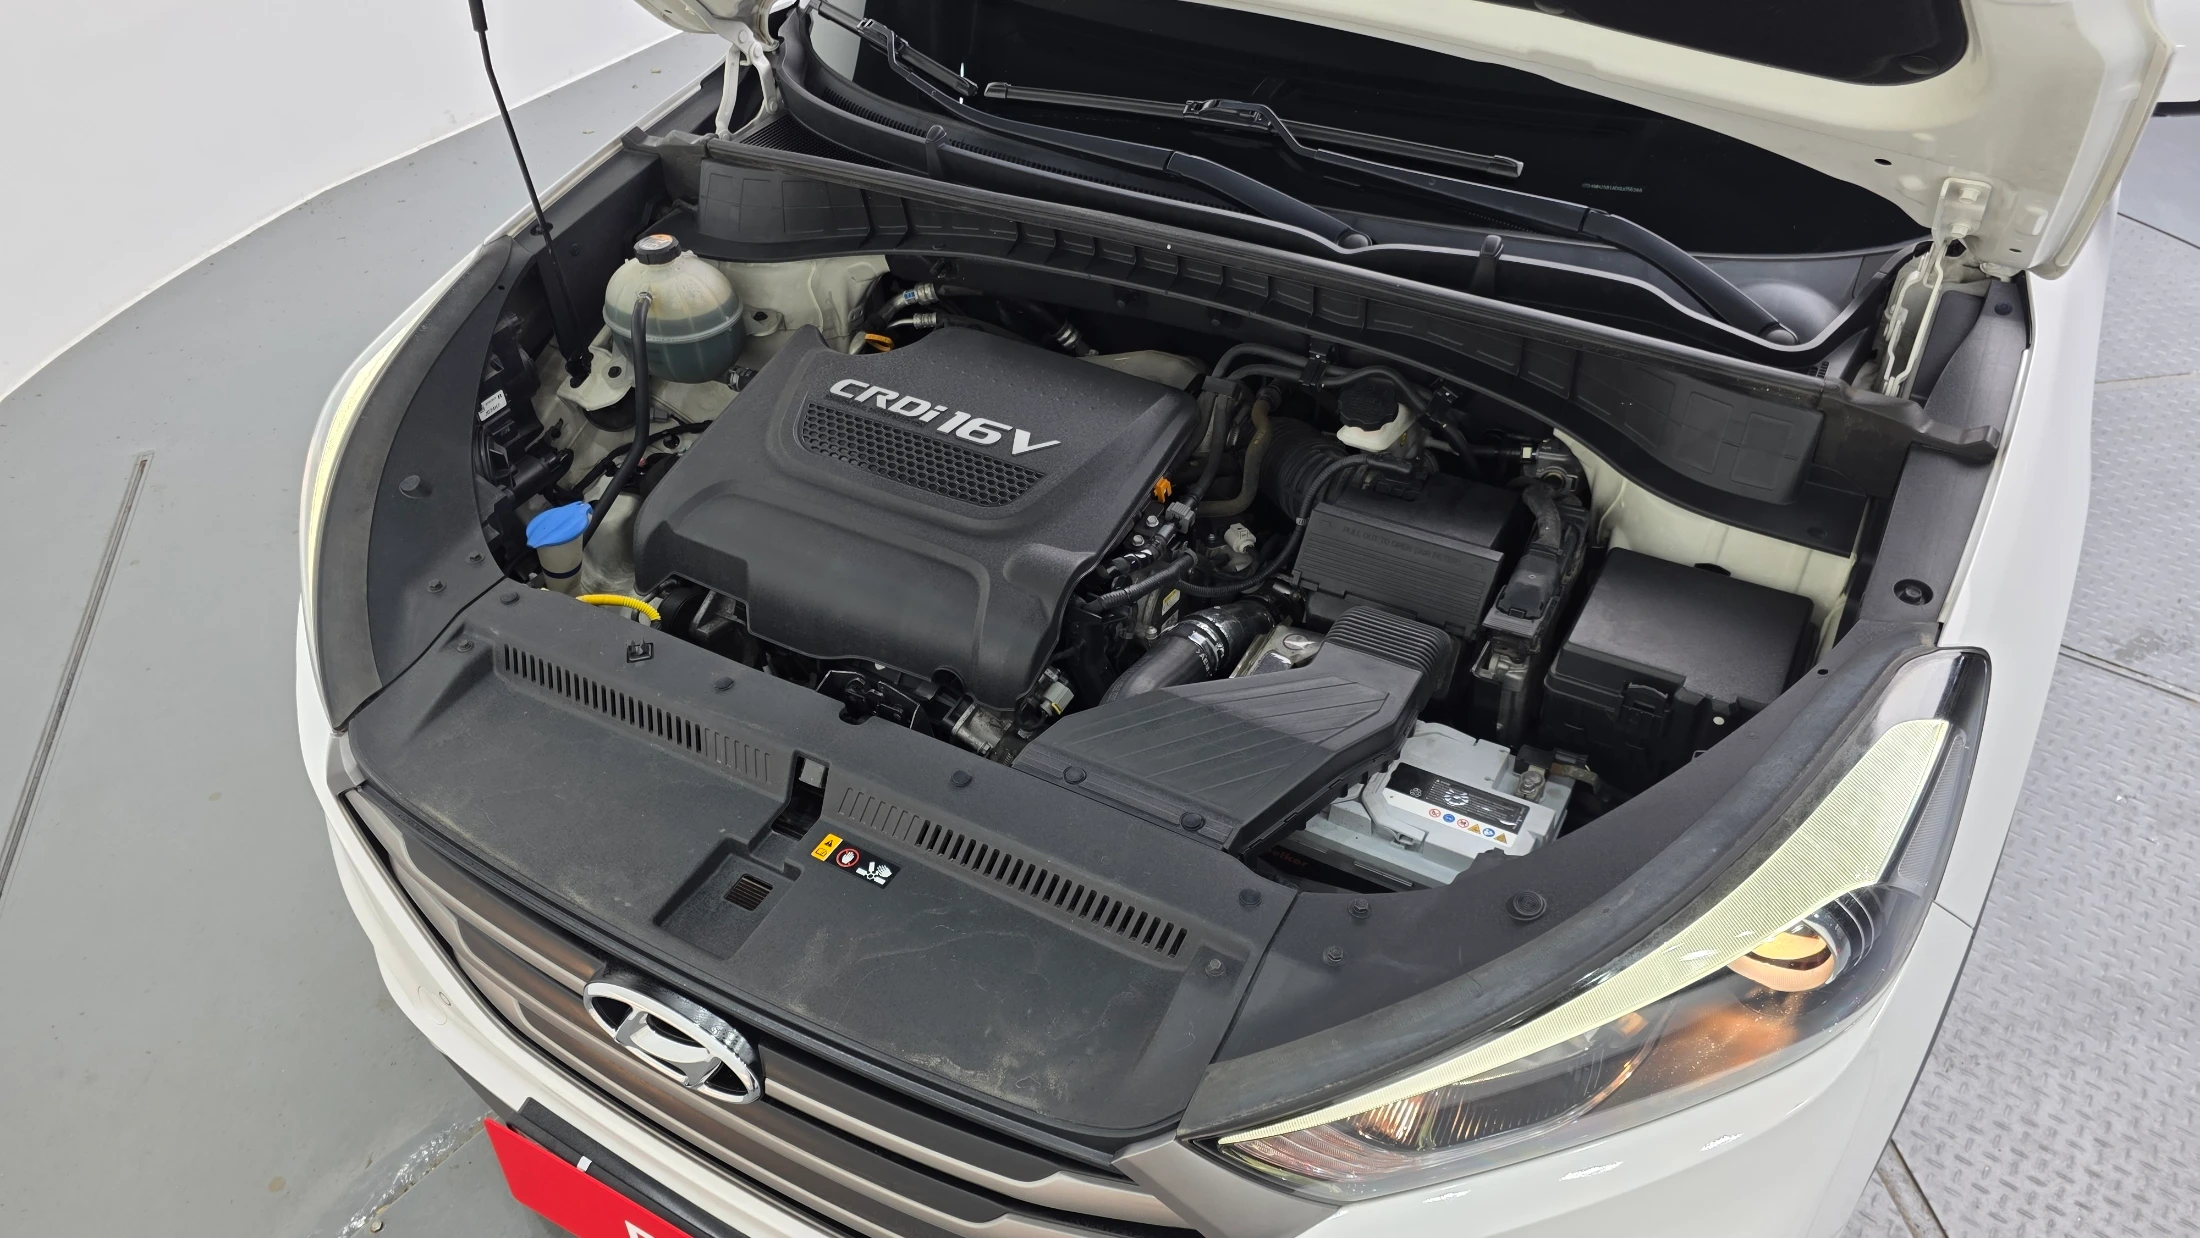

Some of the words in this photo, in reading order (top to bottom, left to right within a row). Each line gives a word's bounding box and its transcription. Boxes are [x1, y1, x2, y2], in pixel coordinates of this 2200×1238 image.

[829, 378, 949, 423] CRDi
[936, 410, 1062, 456] 16V
[1342, 525, 1362, 539] PULL
[1362, 531, 1379, 541] OUT
[1379, 535, 1391, 547] TO
[1391, 540, 1412, 553] OPEN
